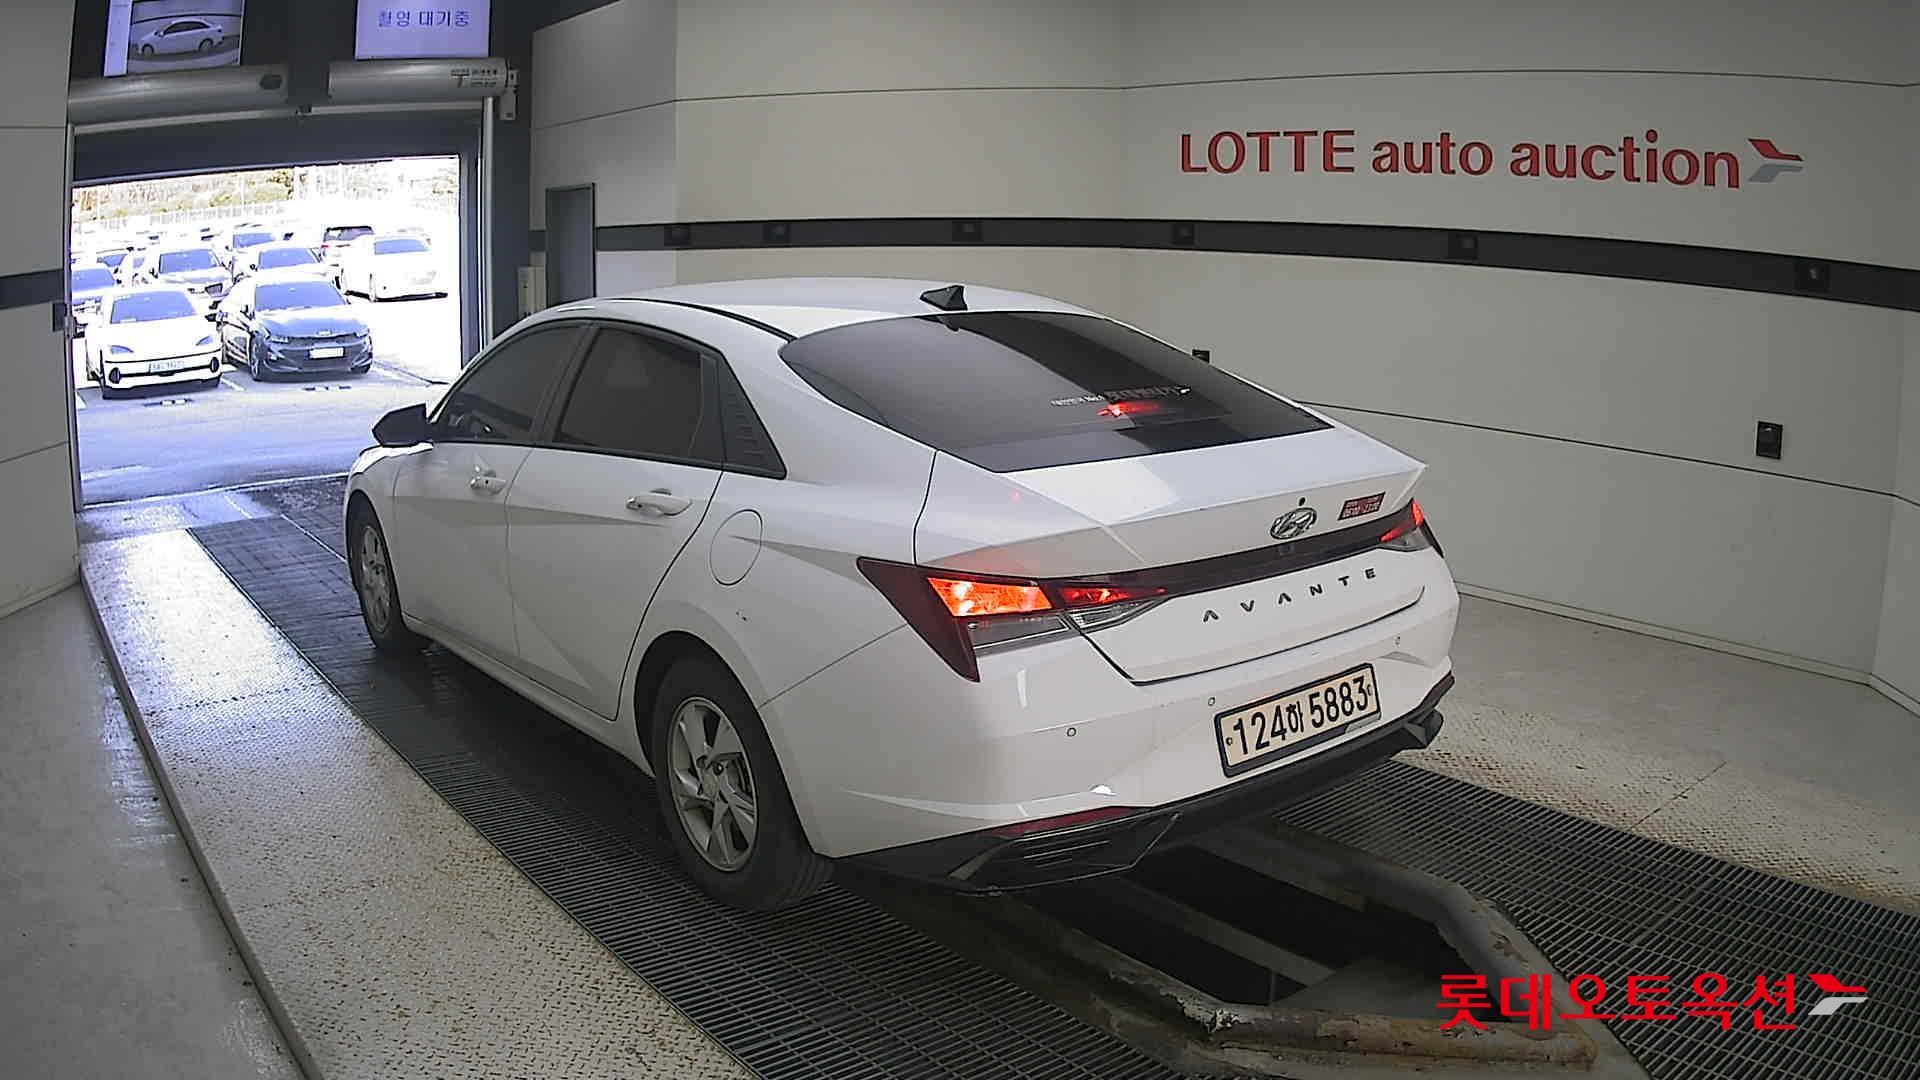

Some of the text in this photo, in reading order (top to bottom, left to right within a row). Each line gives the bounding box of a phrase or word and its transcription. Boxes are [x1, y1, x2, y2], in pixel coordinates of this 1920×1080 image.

[419, 10, 470, 27] 대기중
[1182, 131, 1739, 187] LOTTE auto auction
[1203, 567, 1376, 622] AVANTE
